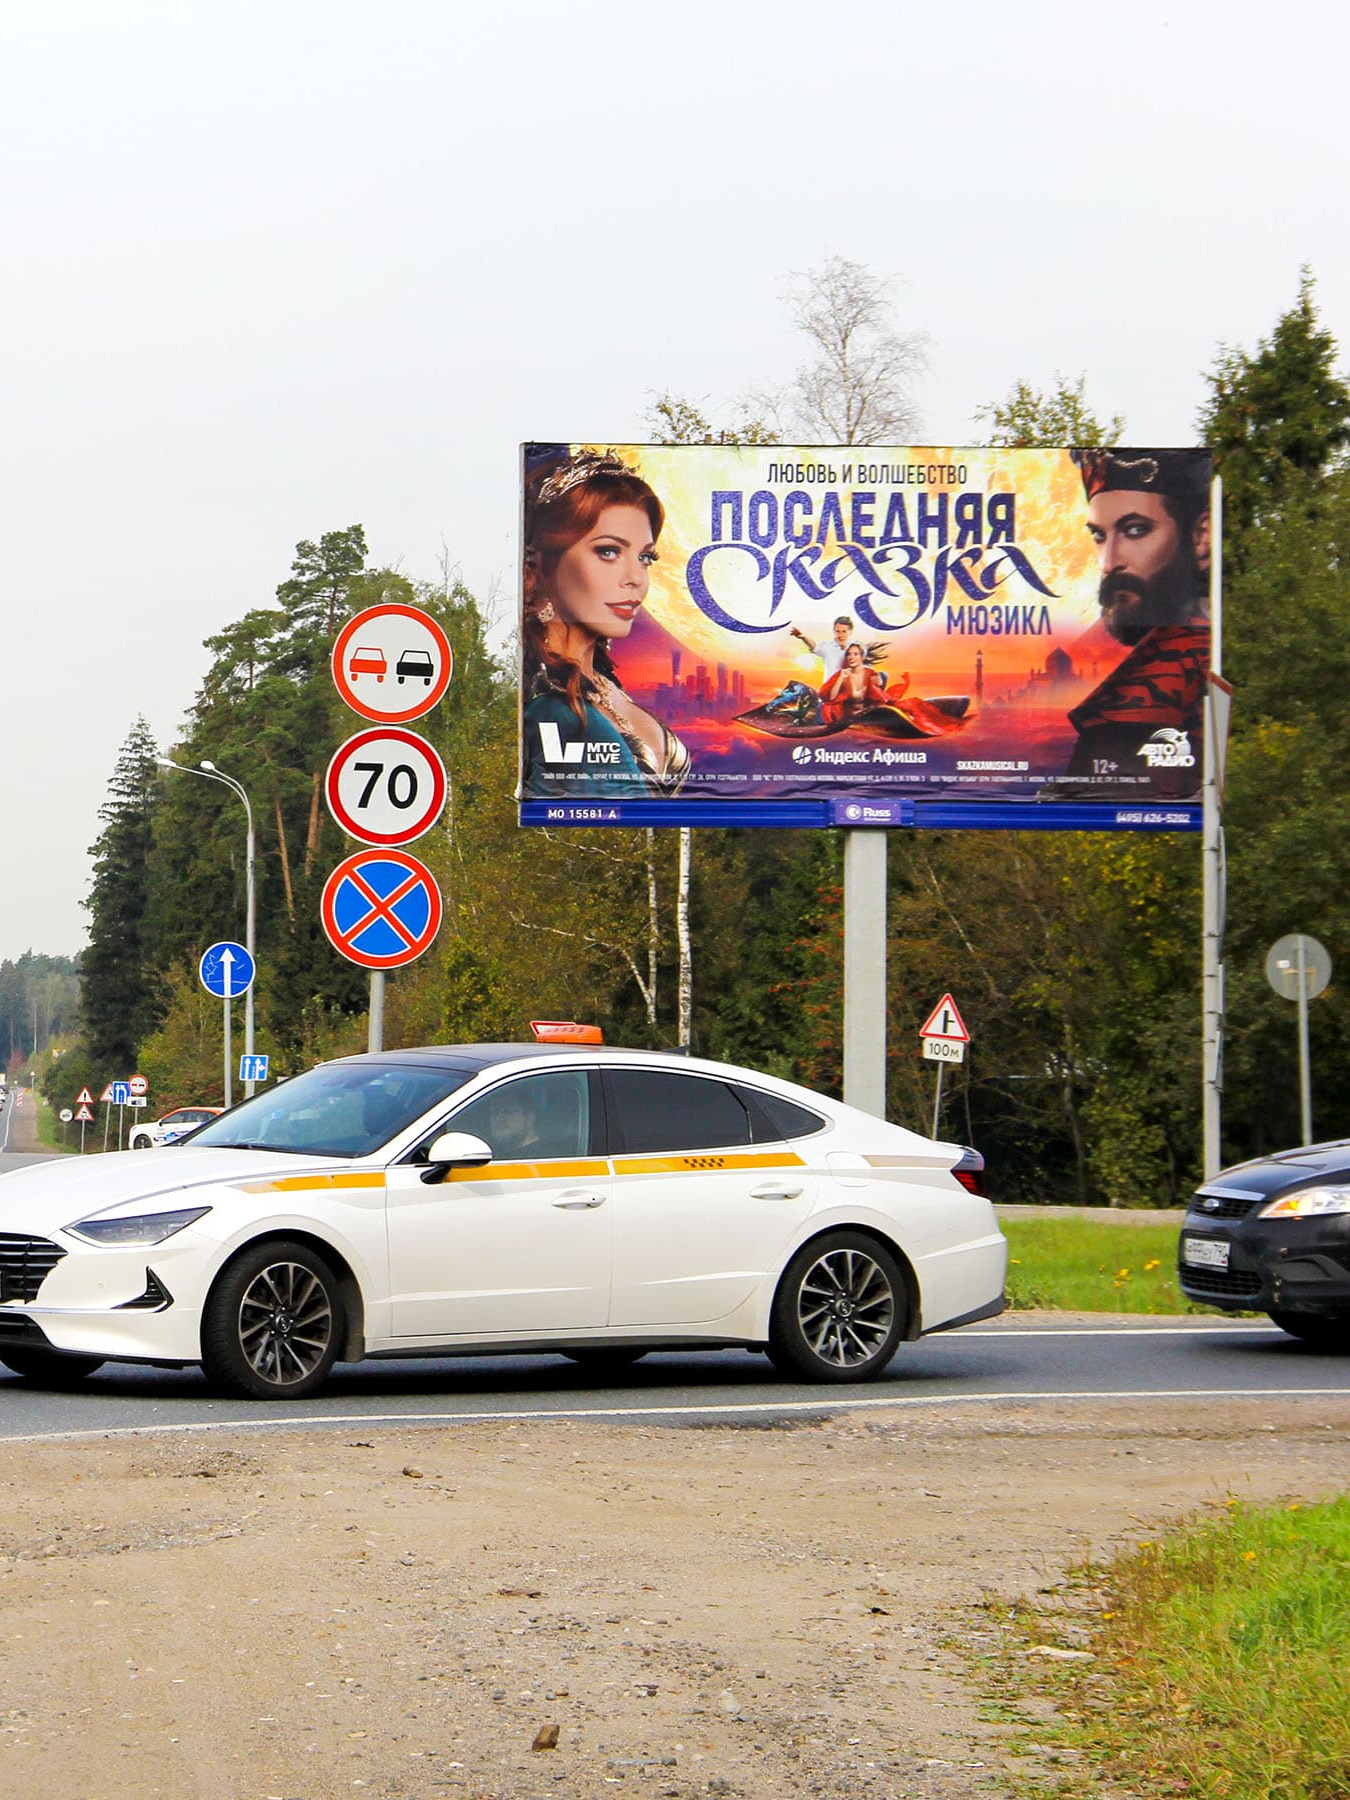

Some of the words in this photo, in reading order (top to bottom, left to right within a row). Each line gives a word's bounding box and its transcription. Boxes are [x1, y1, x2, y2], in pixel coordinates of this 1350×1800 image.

[767, 463, 837, 484] ЛЮБОВЬ
[843, 464, 852, 483] И
[858, 464, 968, 485] ВОЛШЕБСТВО
[711, 490, 1016, 549] ПОСЛЕДНЯЯ
[946, 605, 1053, 636] МЮЗИКЛ
[587, 753, 621, 764] LIVE
[814, 748, 870, 765] Яндекс
[872, 748, 927, 766] Афиша
[1092, 759, 1119, 774] 12+
[354, 762, 418, 809] 70
[569, 809, 602, 819] 15581
[863, 807, 891, 817] Russ
